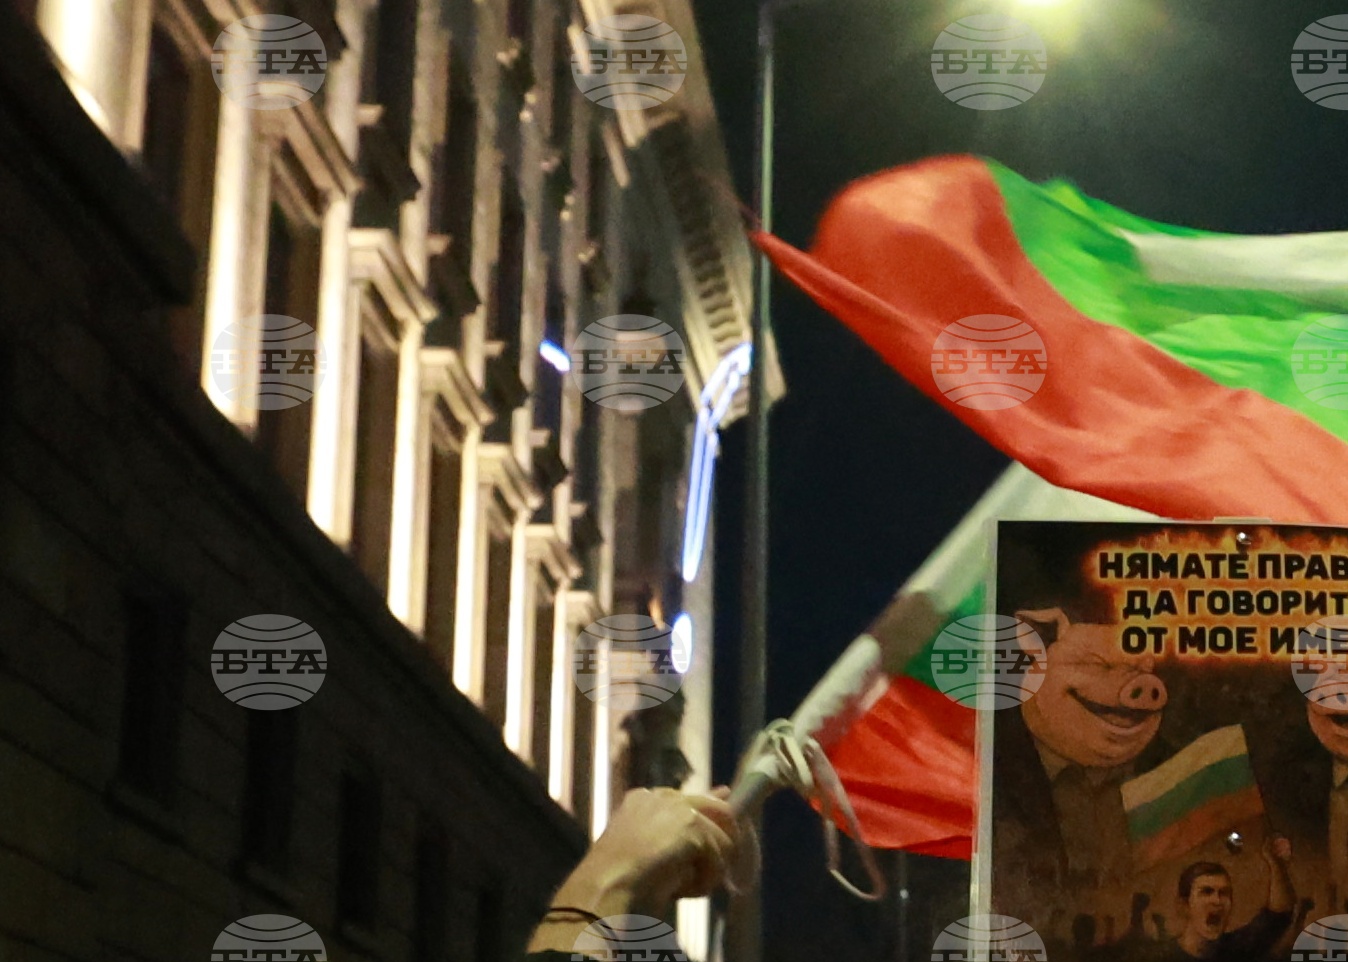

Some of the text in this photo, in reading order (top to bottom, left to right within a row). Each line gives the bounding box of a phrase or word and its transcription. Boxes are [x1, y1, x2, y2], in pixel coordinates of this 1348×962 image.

[1100, 552, 1249, 582] НЯМАТЕ
[1122, 590, 1178, 619] ДА
[1121, 626, 1170, 655] ОТ
[1178, 626, 1257, 655] МОЕ
